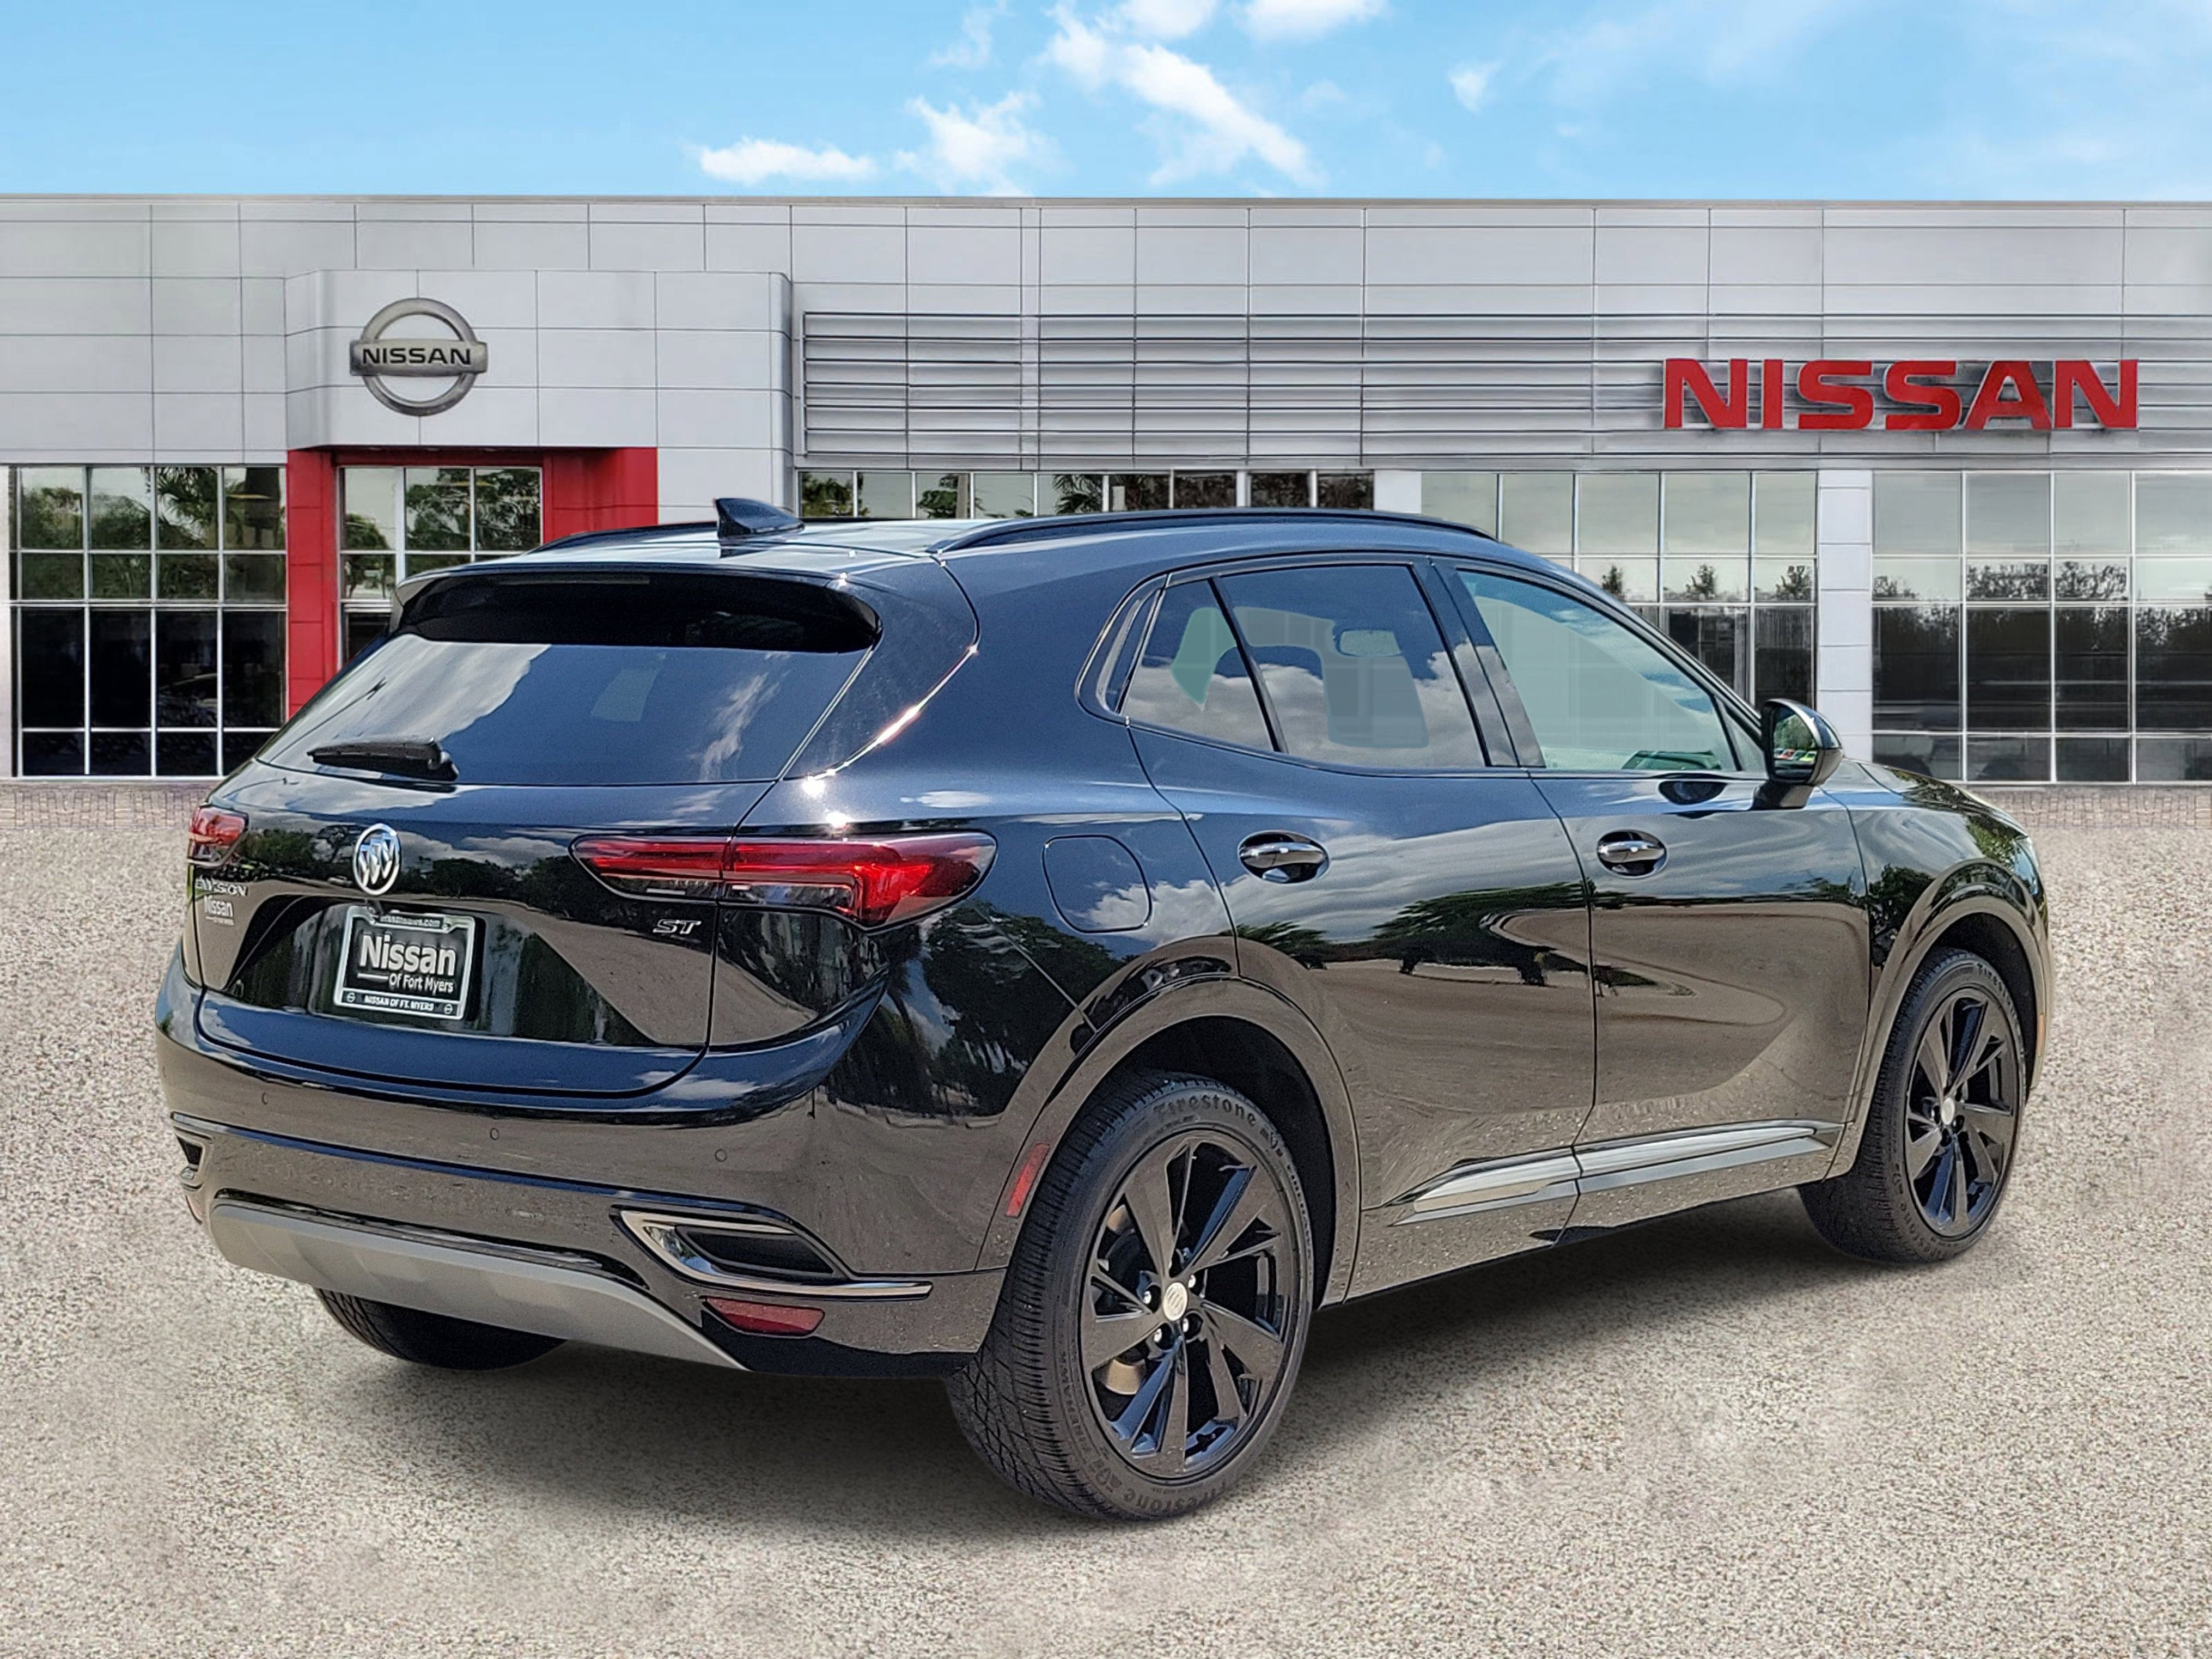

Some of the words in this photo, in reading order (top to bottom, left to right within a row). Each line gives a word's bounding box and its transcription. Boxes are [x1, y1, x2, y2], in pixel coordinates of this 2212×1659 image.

[363, 348, 471, 365] NISSAN
[1663, 358, 2140, 431] NISSAN
[653, 919, 702, 934] ST
[359, 934, 456, 977] Nissan
[389, 973, 402, 987] Of
[403, 974, 423, 990] Fort
[424, 977, 454, 996] Myers
[364, 995, 389, 1006] NISSAN
[389, 998, 398, 1007] OF
[410, 1001, 435, 1011] MYERS
[1153, 1093, 1257, 1126] Firestone
